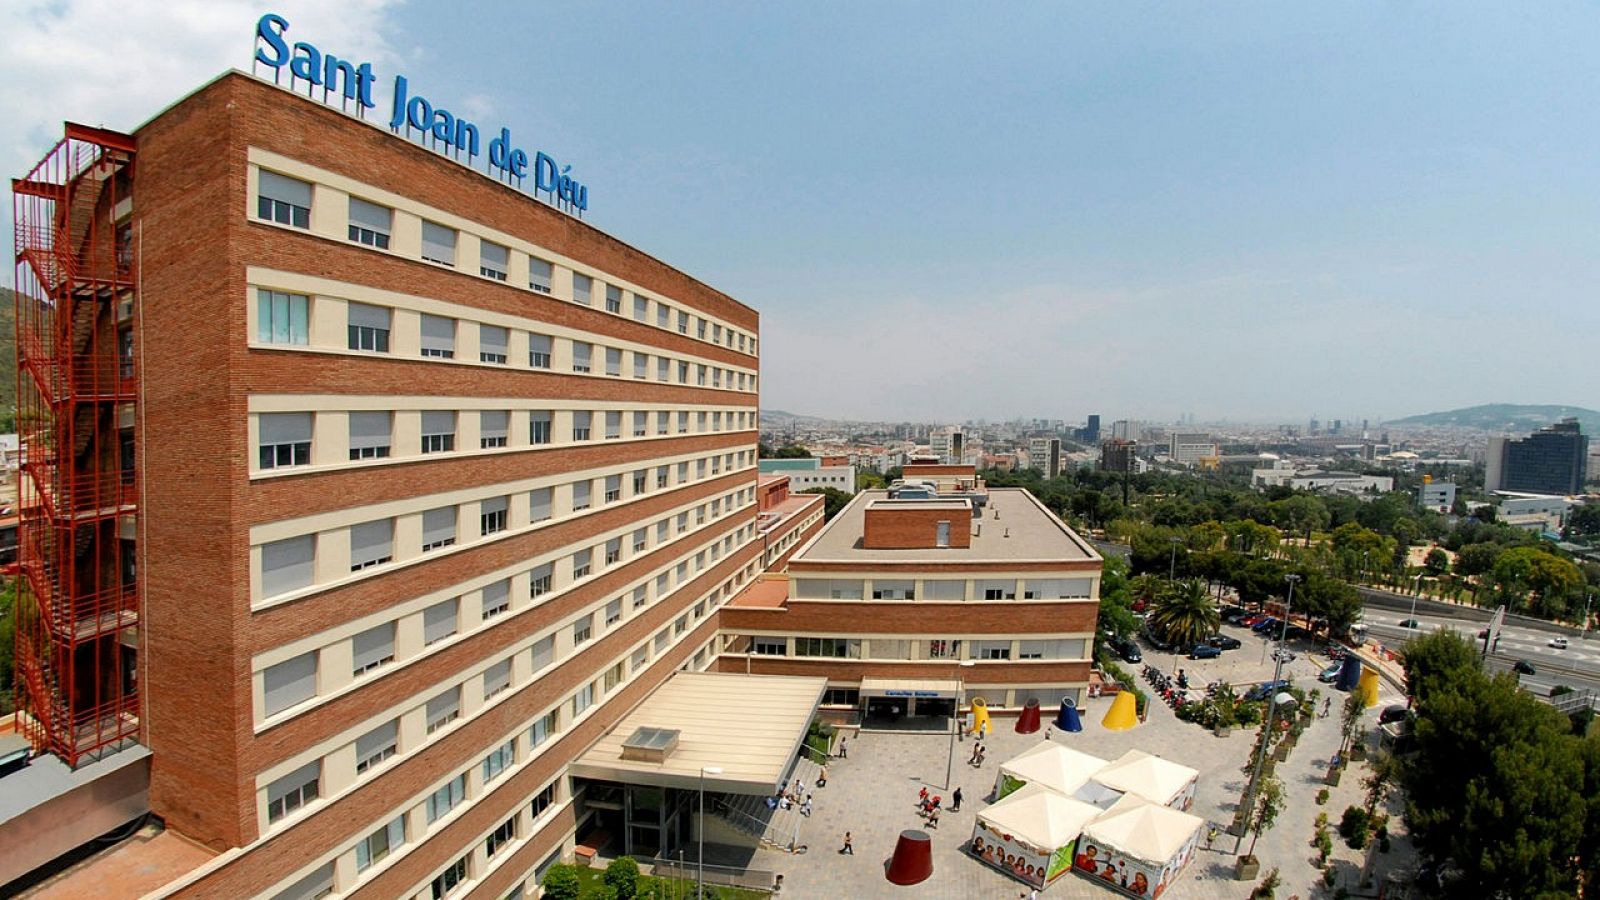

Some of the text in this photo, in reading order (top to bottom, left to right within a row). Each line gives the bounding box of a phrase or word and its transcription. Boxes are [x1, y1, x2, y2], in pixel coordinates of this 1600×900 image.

[255, 13, 588, 210] Sant Joan de Déu
